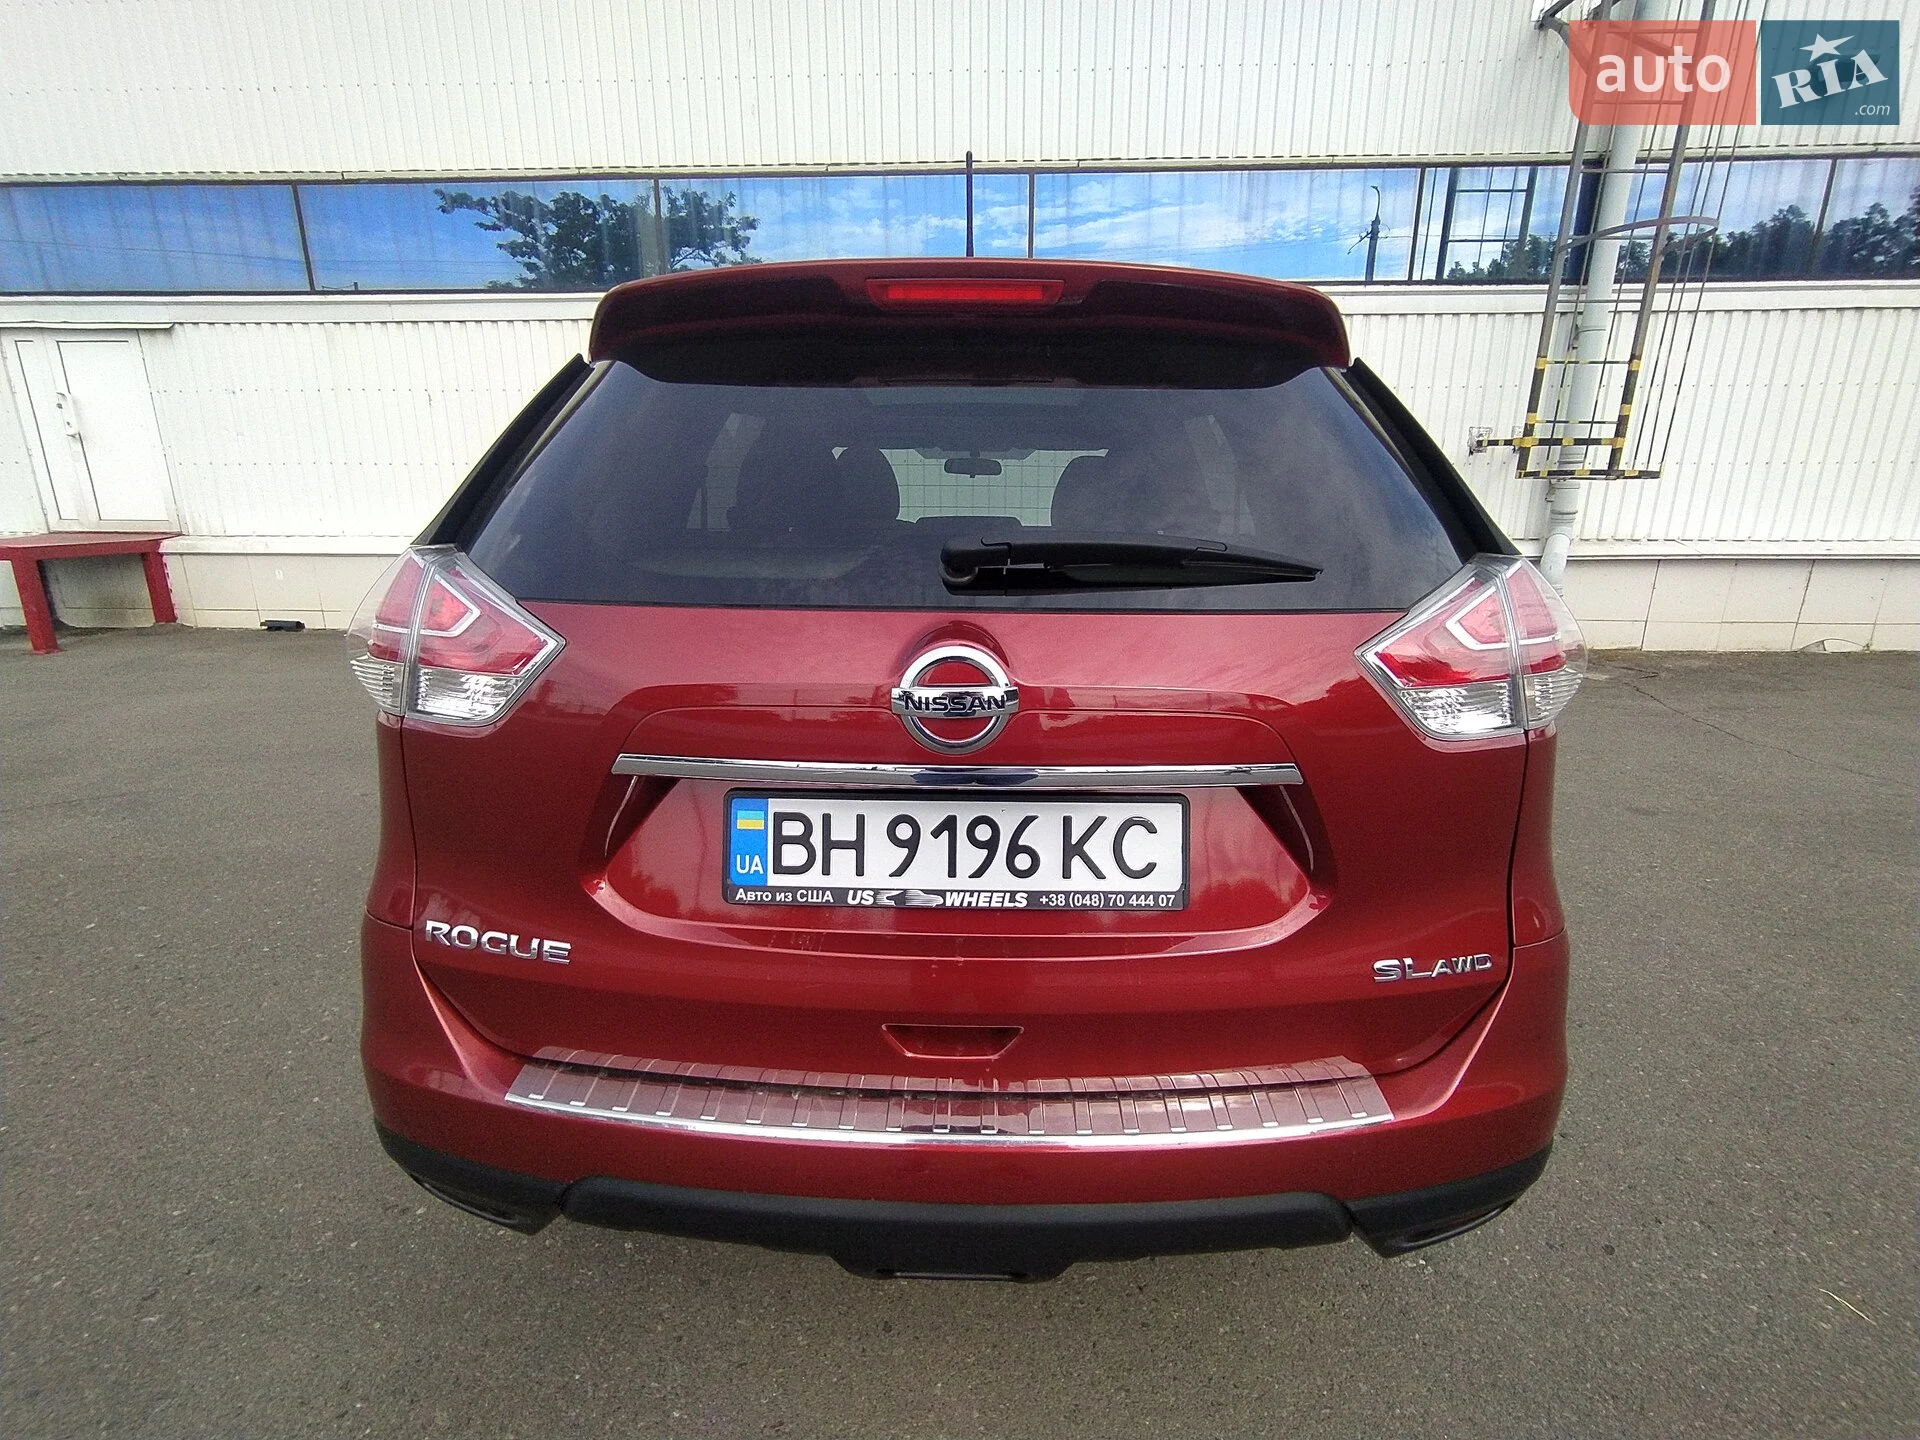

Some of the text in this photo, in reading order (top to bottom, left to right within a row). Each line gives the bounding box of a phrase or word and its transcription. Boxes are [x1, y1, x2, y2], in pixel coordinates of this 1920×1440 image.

[903, 694, 1006, 711] NISSAN
[772, 812, 1158, 880] BH 9196 KC
[736, 854, 764, 875] UA
[735, 888, 834, 904] Авто из США
[846, 890, 1028, 907] US WHEELS
[1039, 892, 1176, 908] +38 (048) 70 444 07
[425, 919, 572, 965] ROGUE
